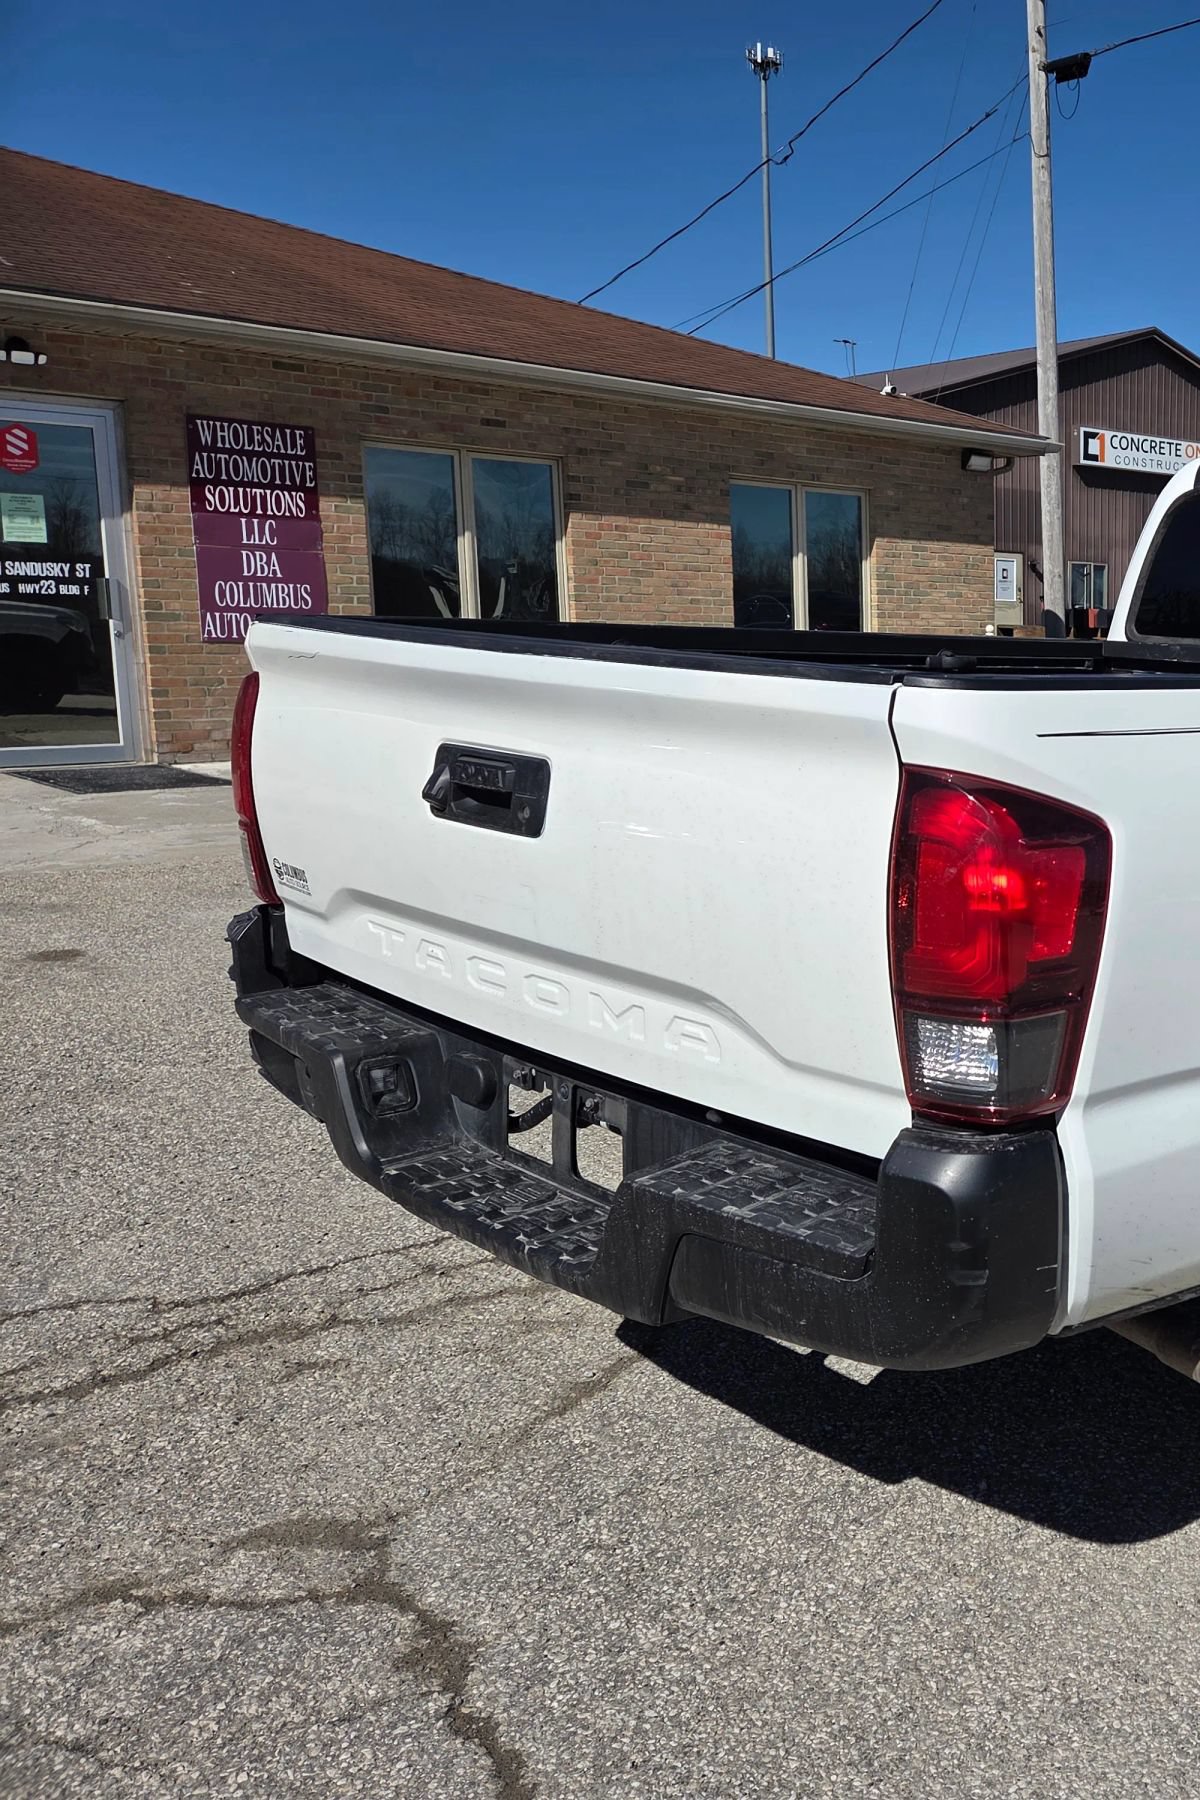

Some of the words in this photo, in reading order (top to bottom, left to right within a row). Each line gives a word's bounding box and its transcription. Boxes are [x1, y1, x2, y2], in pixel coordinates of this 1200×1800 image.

[196, 419, 306, 456] WHOLESALE
[1110, 434, 1182, 457] CONCRETE
[192, 452, 315, 487] AUTOMOTIVE
[205, 484, 306, 518] SOLUTIONS
[240, 518, 277, 546] LLC
[5, 560, 70, 578] SANDUSKY
[75, 563, 91, 578] ST
[241, 550, 283, 578] DBA
[59, 584, 81, 595] BLDG
[83, 585, 90, 596] F
[214, 580, 312, 610] COLUMBUS
[203, 612, 252, 639] AUTO
[367, 920, 722, 1064] TACOMA
